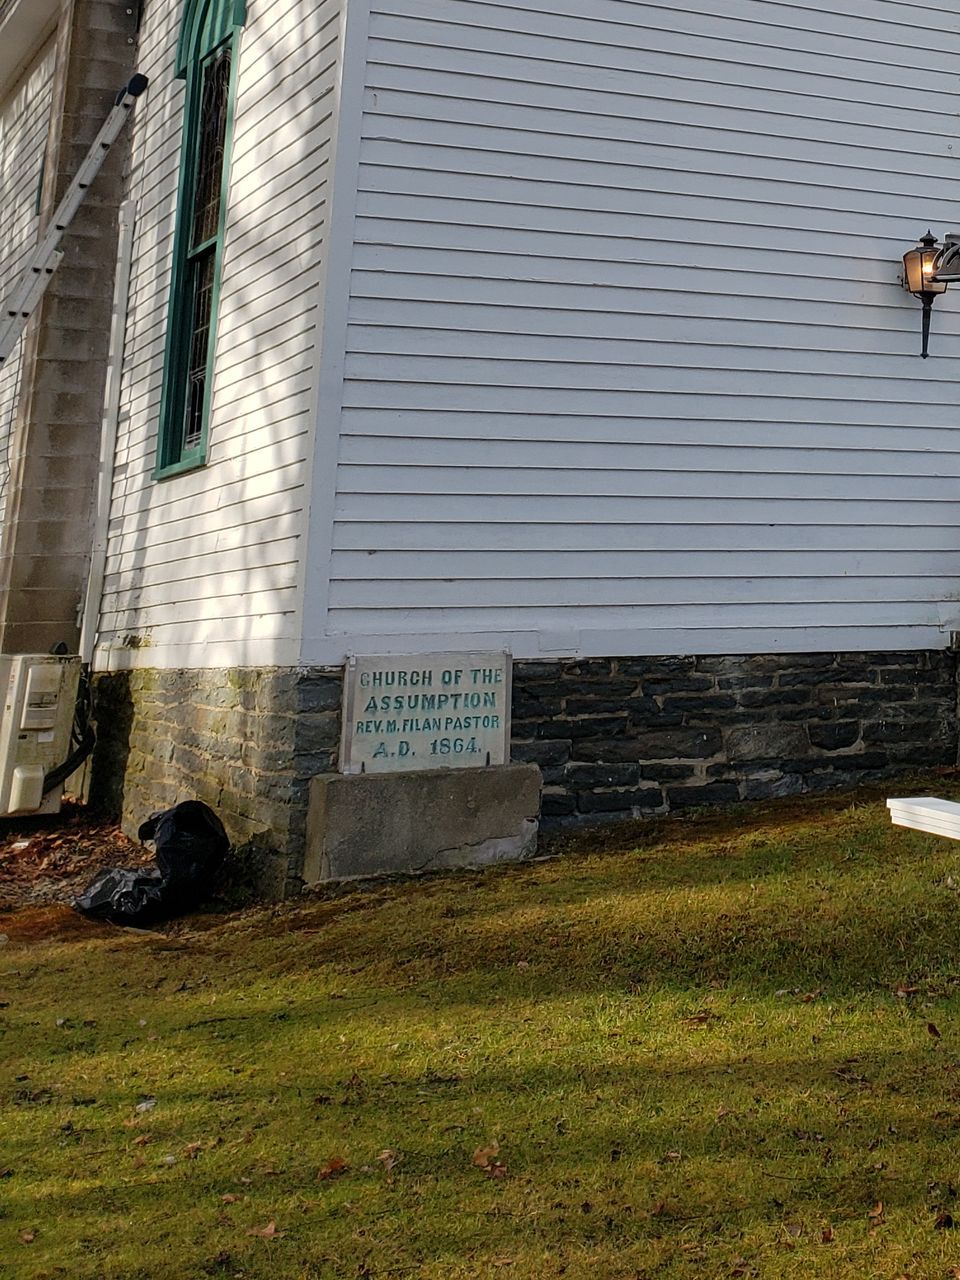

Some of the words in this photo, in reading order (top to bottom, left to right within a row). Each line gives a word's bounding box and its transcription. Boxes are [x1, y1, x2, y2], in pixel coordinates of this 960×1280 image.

[360, 670, 433, 688] CHURCH
[442, 670, 463, 686] OF
[471, 668, 503, 684] THE
[364, 692, 496, 713] ASSUMPTION
[356, 720, 384, 734] REV.
[403, 719, 442, 732] FILAN
[445, 715, 500, 731] PASTOR
